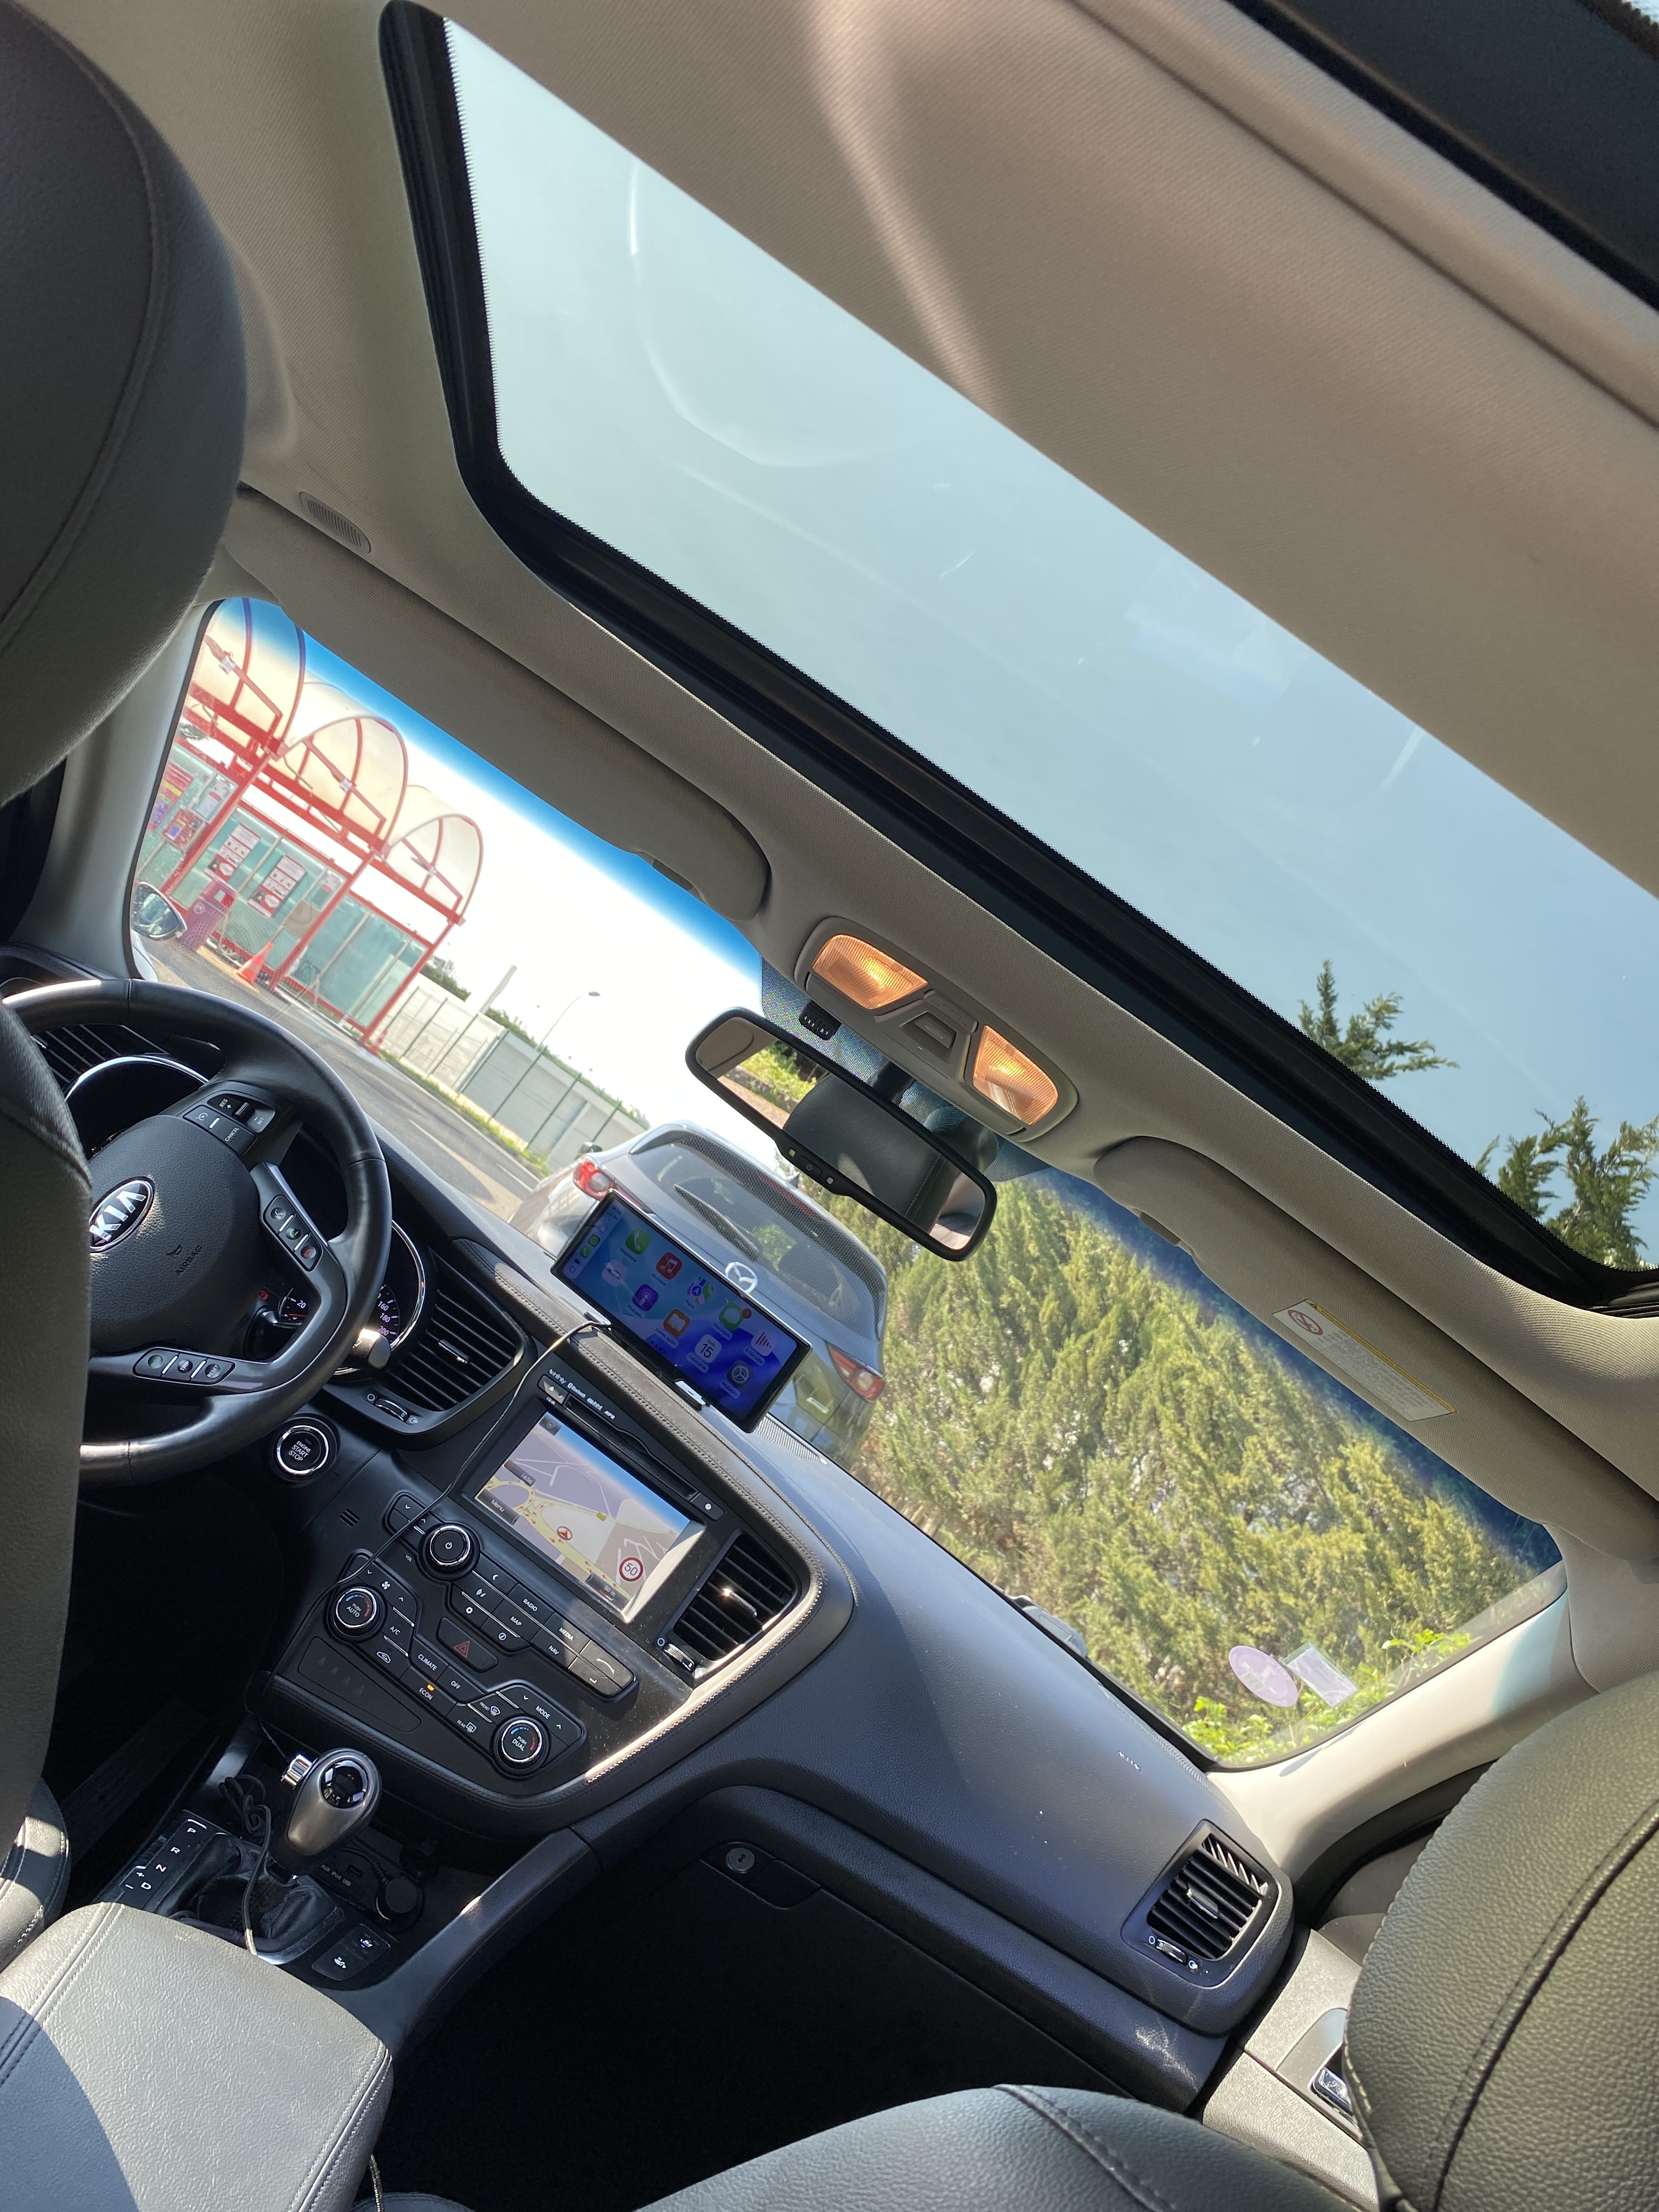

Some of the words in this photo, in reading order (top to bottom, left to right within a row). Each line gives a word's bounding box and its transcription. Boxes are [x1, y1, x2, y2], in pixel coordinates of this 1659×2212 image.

[219, 1098, 228, 1108] RES
[256, 1117, 265, 1125] SET
[225, 1127, 240, 1142] CANCEL
[89, 1190, 146, 1242] KIA
[176, 1245, 204, 1276] AIRBAG
[296, 1300, 306, 1308] 20
[377, 1301, 389, 1311] 160
[379, 1312, 391, 1323] 180
[377, 1325, 389, 1336] 200
[700, 1344, 714, 1358] 15
[151, 1356, 161, 1367] eco
[180, 1361, 189, 1371] TRIP
[207, 1364, 219, 1378] RESET
[292, 1444, 309, 1458] START
[296, 1441, 312, 1453] ENGINE
[289, 1450, 303, 1462] STOP
[490, 1499, 505, 1513] Menu
[624, 1563, 638, 1576] 50
[352, 1603, 362, 1612] PUSH
[523, 1599, 538, 1611] RADIO
[346, 1606, 360, 1617] AUTO
[510, 1616, 522, 1626] MAP
[390, 1626, 400, 1635] A/C
[558, 1627, 574, 1641] MEDIA
[549, 1645, 560, 1655] NAV
[418, 1654, 438, 1671] CLIMATE
[450, 1680, 461, 1690] OFF
[419, 1688, 433, 1700] ECON
[479, 1702, 490, 1712] FRONT
[535, 1706, 550, 1719] MODE
[457, 1719, 466, 1728] REAR
[512, 1739, 525, 1752] DUAL
[517, 1736, 527, 1745] PUSH
